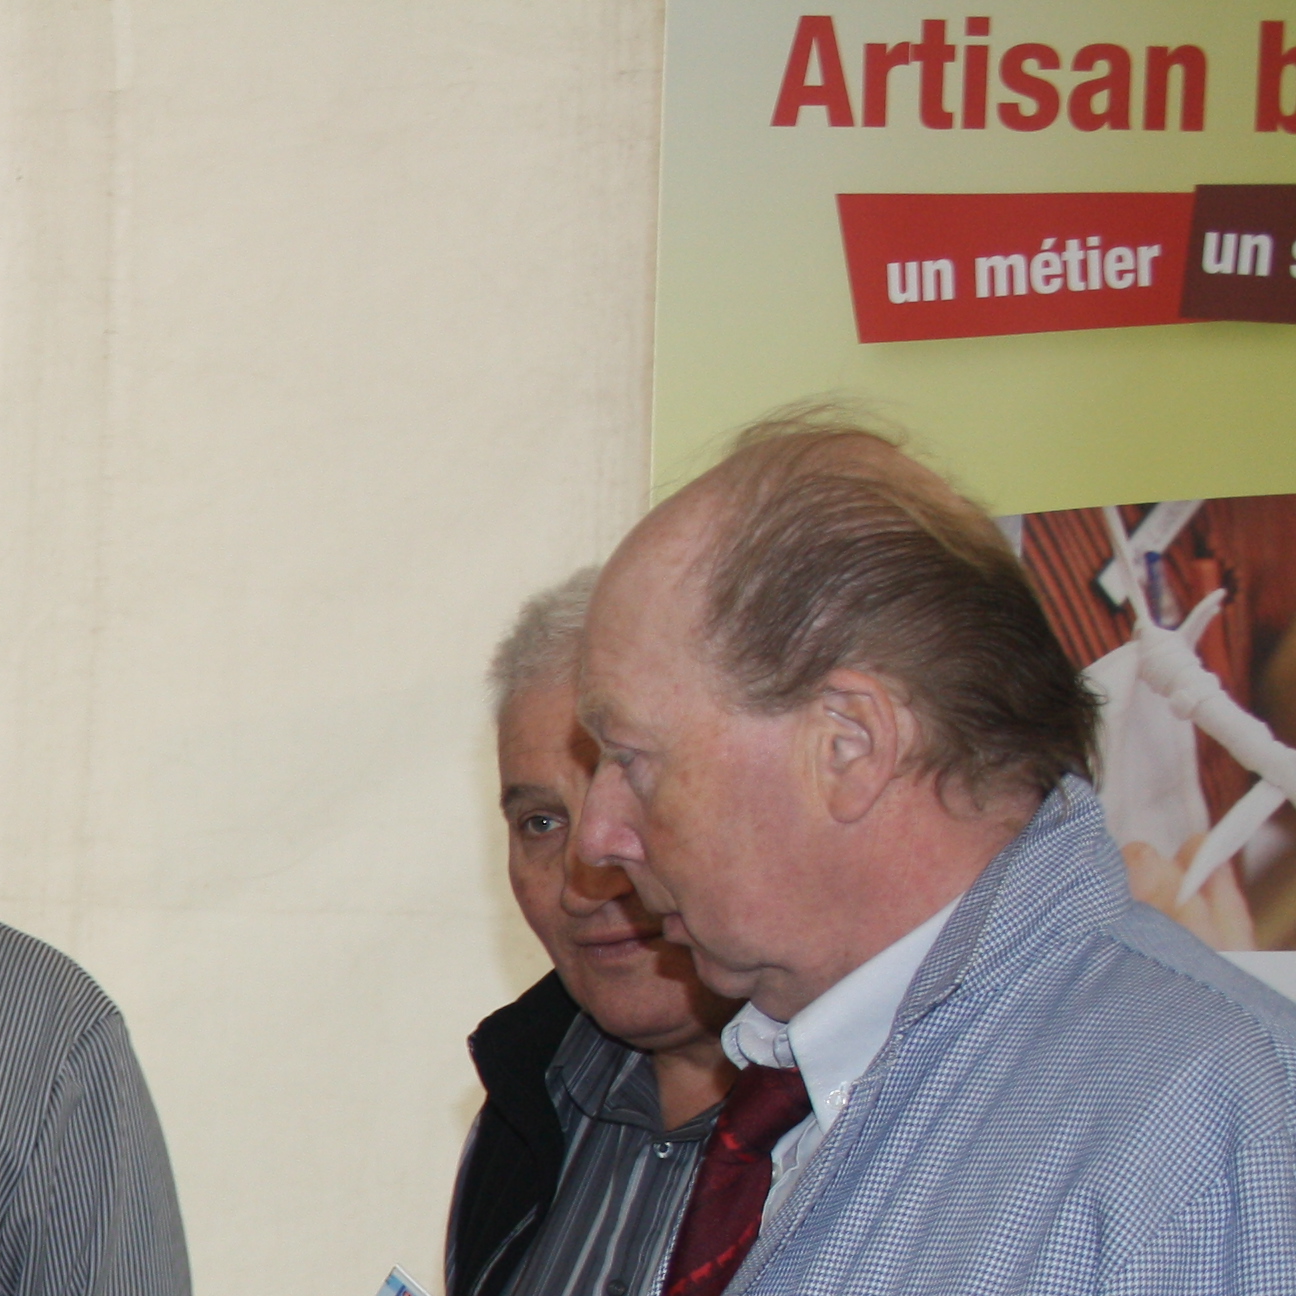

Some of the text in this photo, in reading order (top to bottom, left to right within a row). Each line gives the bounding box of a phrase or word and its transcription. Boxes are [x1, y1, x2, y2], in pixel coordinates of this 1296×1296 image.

[770, 15, 1207, 133] Artisan
[886, 257, 955, 305] un
[975, 238, 1162, 299] métier
[1201, 231, 1273, 277] un
